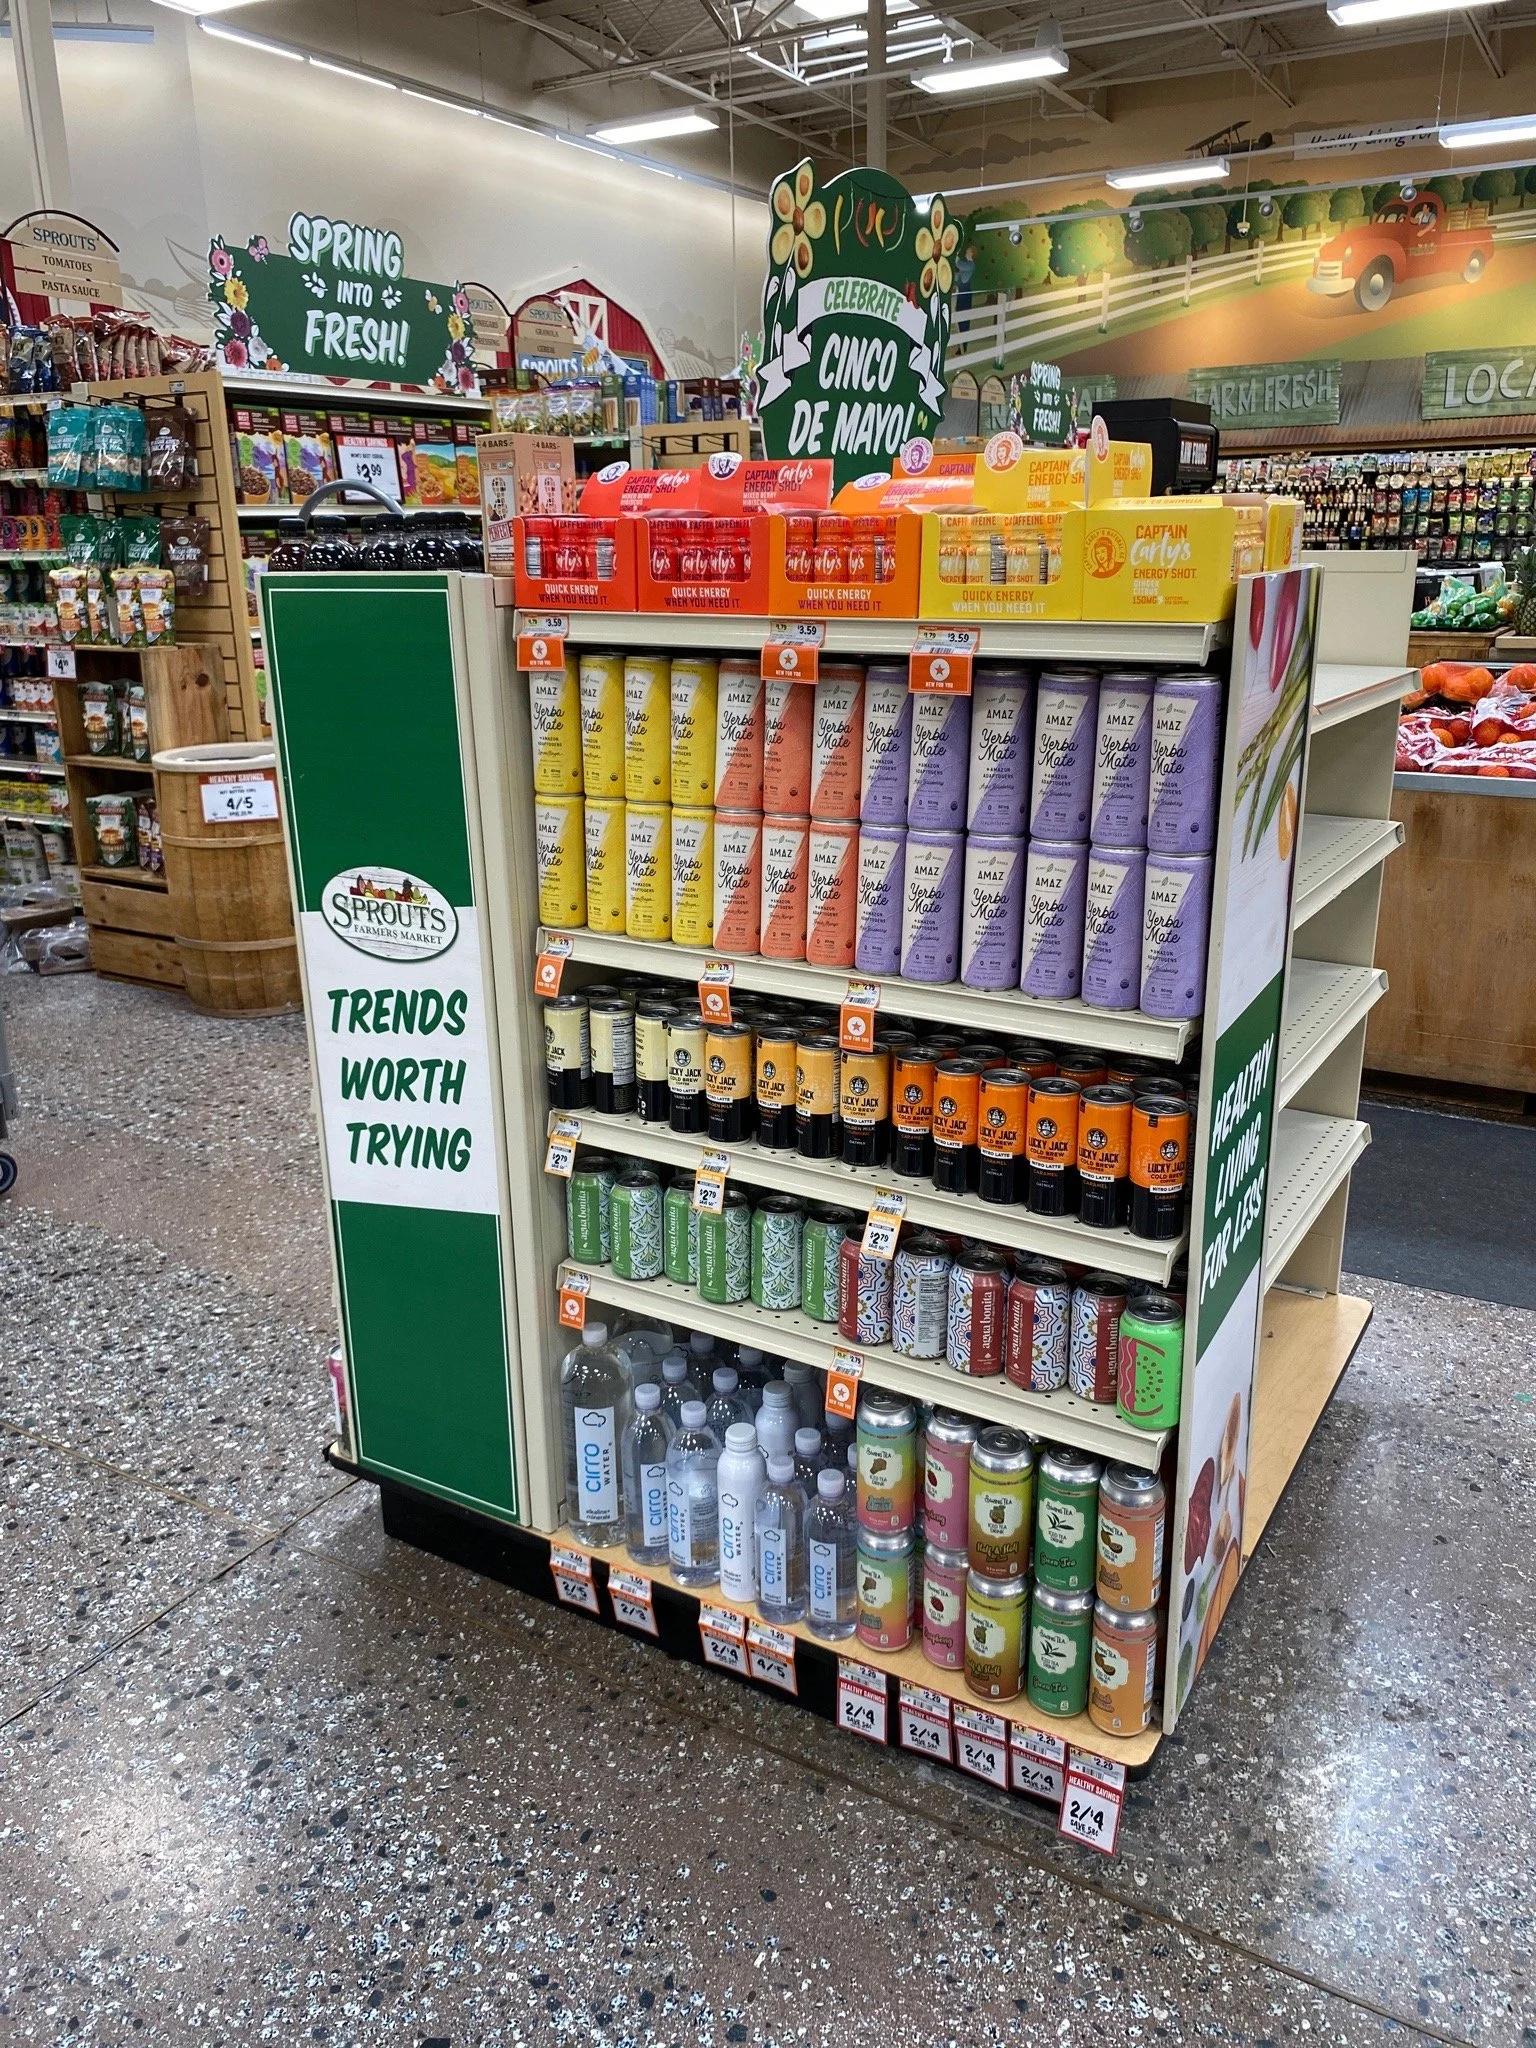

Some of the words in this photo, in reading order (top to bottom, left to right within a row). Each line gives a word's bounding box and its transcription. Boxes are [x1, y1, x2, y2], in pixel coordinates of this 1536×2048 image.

[33, 227, 96, 251] SPROUTS
[290, 213, 402, 278] SPRING
[42, 255, 93, 272] TOMATOES
[42, 280, 70, 293] PASTA
[72, 286, 100, 298] SAUCE
[336, 279, 373, 308] INTO
[824, 281, 903, 324] CELEBRATE
[529, 308, 562, 321] SPROUTS
[304, 309, 410, 367] FRESH!
[521, 358, 578, 381] SPROUTS
[819, 333, 897, 393] CINCO
[1030, 361, 1061, 391] SPRING
[1264, 369, 1332, 412] FRESH
[788, 399, 829, 455] DE
[834, 400, 914, 456] MAYO!
[1033, 409, 1061, 434] FRESH!
[488, 440, 508, 448] BARS
[745, 470, 778, 480] CAPTAIN
[778, 462, 814, 485] Carly's
[939, 464, 975, 476] CAPTAIN
[1029, 461, 1070, 474] CAPTAIN
[627, 476, 657, 485] CAPTAIN
[657, 470, 690, 488] Carly's
[743, 481, 777, 492] ENERGY
[779, 481, 802, 492] SHOT
[1028, 474, 1069, 487] ENERGY
[624, 485, 655, 494] ENERGY
[1136, 524, 1188, 540] CAPTAIN
[1130, 532, 1191, 567] Carly's
[1133, 568, 1169, 580] ENERGY
[544, 584, 568, 595] QUICK
[570, 584, 599, 596] ENERGY
[671, 587, 698, 599] QUICK
[700, 588, 731, 599] ENERGY
[807, 588, 834, 600] QUICK
[836, 588, 872, 601] ENERGY
[962, 590, 993, 602] QUICK
[995, 590, 1034, 602] ENERGY
[664, 598, 688, 607] WHEN
[690, 598, 706, 608] YOU
[708, 599, 730, 609] NEED
[797, 600, 822, 611] WHEN
[824, 600, 842, 611] YOU
[844, 600, 868, 612] NEED
[952, 602, 978, 614] WHEN
[979, 602, 1001, 614] YOU
[1002, 602, 1029, 614] NEED
[536, 687, 557, 696] AMAZ
[727, 693, 752, 703] AMAZ
[534, 702, 565, 719] Yerba
[721, 710, 756, 728] Yerba
[537, 717, 564, 731] Mate
[1046, 715, 1073, 726] AMAZ
[720, 727, 754, 741] Mate
[1039, 733, 1078, 753] Yerba
[1038, 751, 1076, 768] Mate
[208, 775, 237, 784] HEALTHY
[238, 773, 265, 781] SAVINGS
[977, 870, 1005, 881] AMAZ
[971, 887, 1010, 907] Yerba
[1151, 891, 1177, 903] AMAZ
[332, 893, 447, 932] SPROUTS
[970, 904, 1008, 920] Mate
[1146, 909, 1183, 930] Yerba
[354, 924, 399, 939] FARMERS
[400, 930, 443, 945] MARKET
[1145, 926, 1181, 945] Mate
[327, 988, 469, 1036] TRENDS
[341, 1056, 467, 1105] WORTH
[842, 1095, 860, 1106] LUCKY
[861, 1097, 879, 1107] JACK
[1210, 1032, 1274, 1157] HEALTHY
[346, 1122, 472, 1172] TRYING
[1029, 1136, 1046, 1150] LUCKY
[1049, 1140, 1068, 1152] JACK
[1030, 1148, 1045, 1156] COLD
[1046, 1150, 1065, 1158] BREW
[1214, 1112, 1262, 1218] LIVING
[1201, 1222, 1230, 1305] FOR
[1232, 1167, 1265, 1254] LESS
[980, 1291, 992, 1328] bonita
[1105, 1317, 1119, 1352] bonita
[584, 1443, 601, 1492] cirro
[603, 1448, 611, 1486] WATER
[723, 1518, 734, 1559] cirro
[815, 1565, 825, 1599] cirro
[840, 1682, 864, 1697] HEALTHY
[864, 1688, 885, 1704] SAVINGS
[1069, 1776, 1094, 1792] HEALTHY
[1095, 1785, 1120, 1803] SAVINGS
[1070, 1819, 1086, 1833] SAVE
